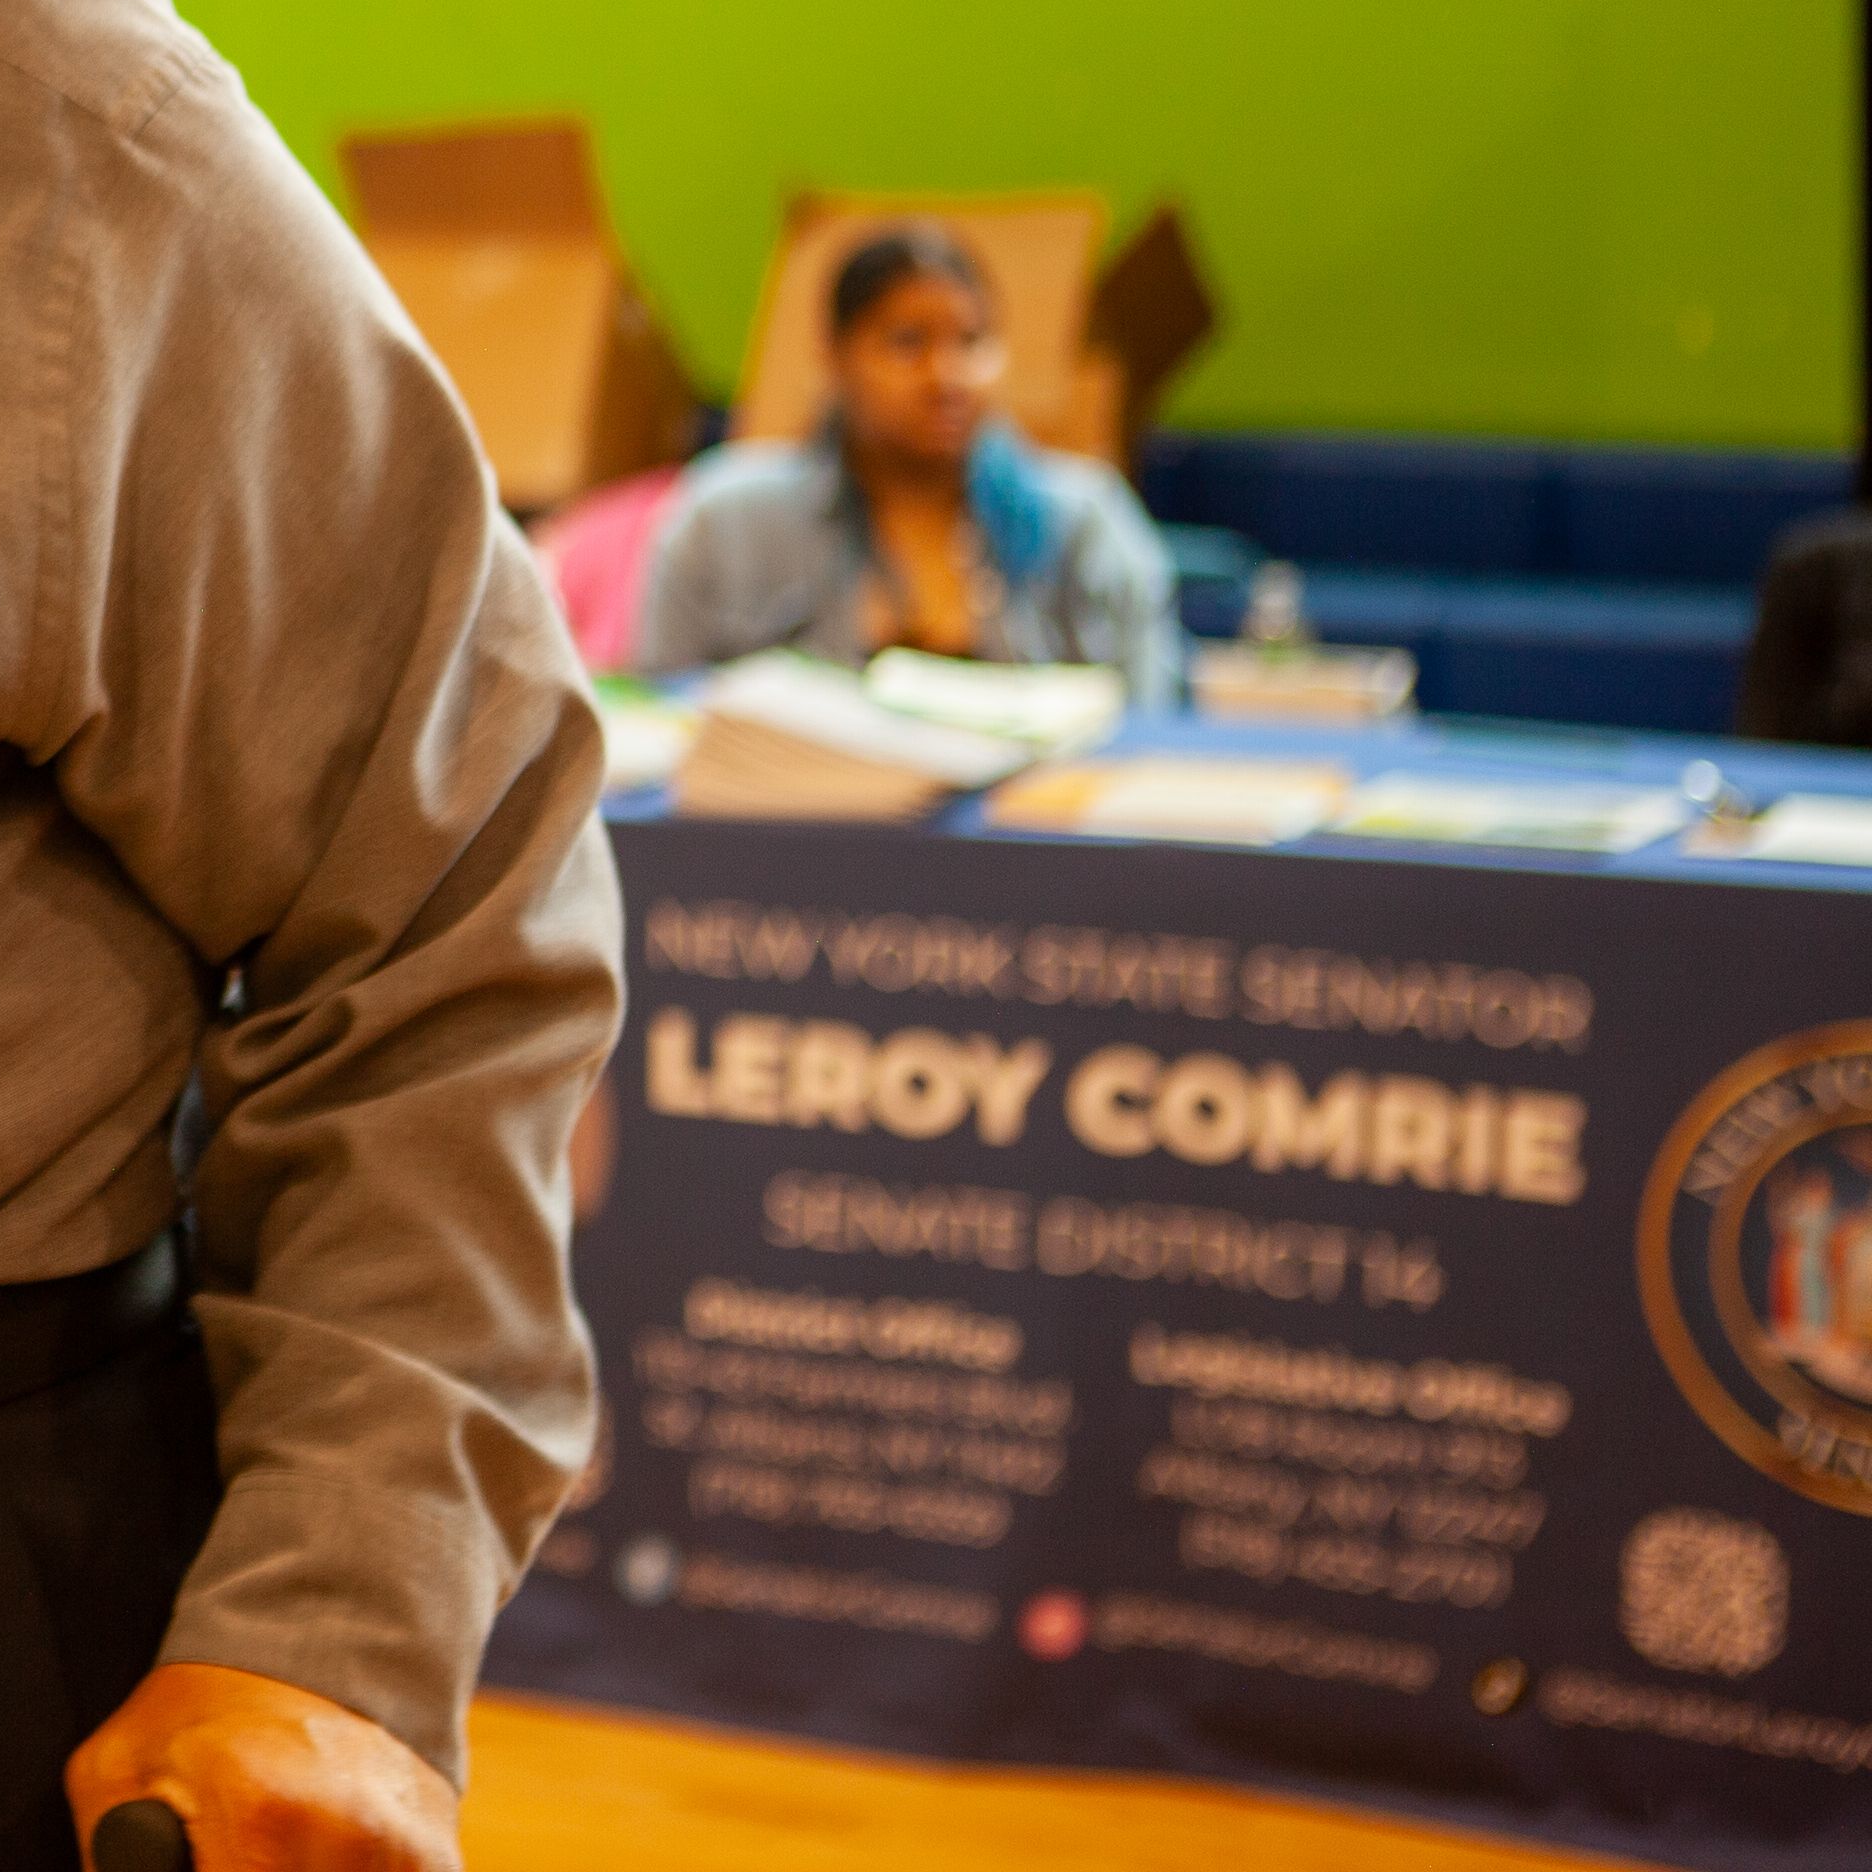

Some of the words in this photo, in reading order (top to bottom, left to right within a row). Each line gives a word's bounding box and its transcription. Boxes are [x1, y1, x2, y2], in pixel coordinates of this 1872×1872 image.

[648, 903, 813, 978] NEW
[830, 914, 1010, 994] YORK
[1020, 923, 1231, 1017] STATE
[1243, 946, 1592, 1052] SENATOR
[647, 1008, 1049, 1146] LEROY
[1067, 1045, 1587, 1205] COMRIE
[765, 1172, 1028, 1270] SENATE
[1038, 1197, 1346, 1302] DISTRICT
